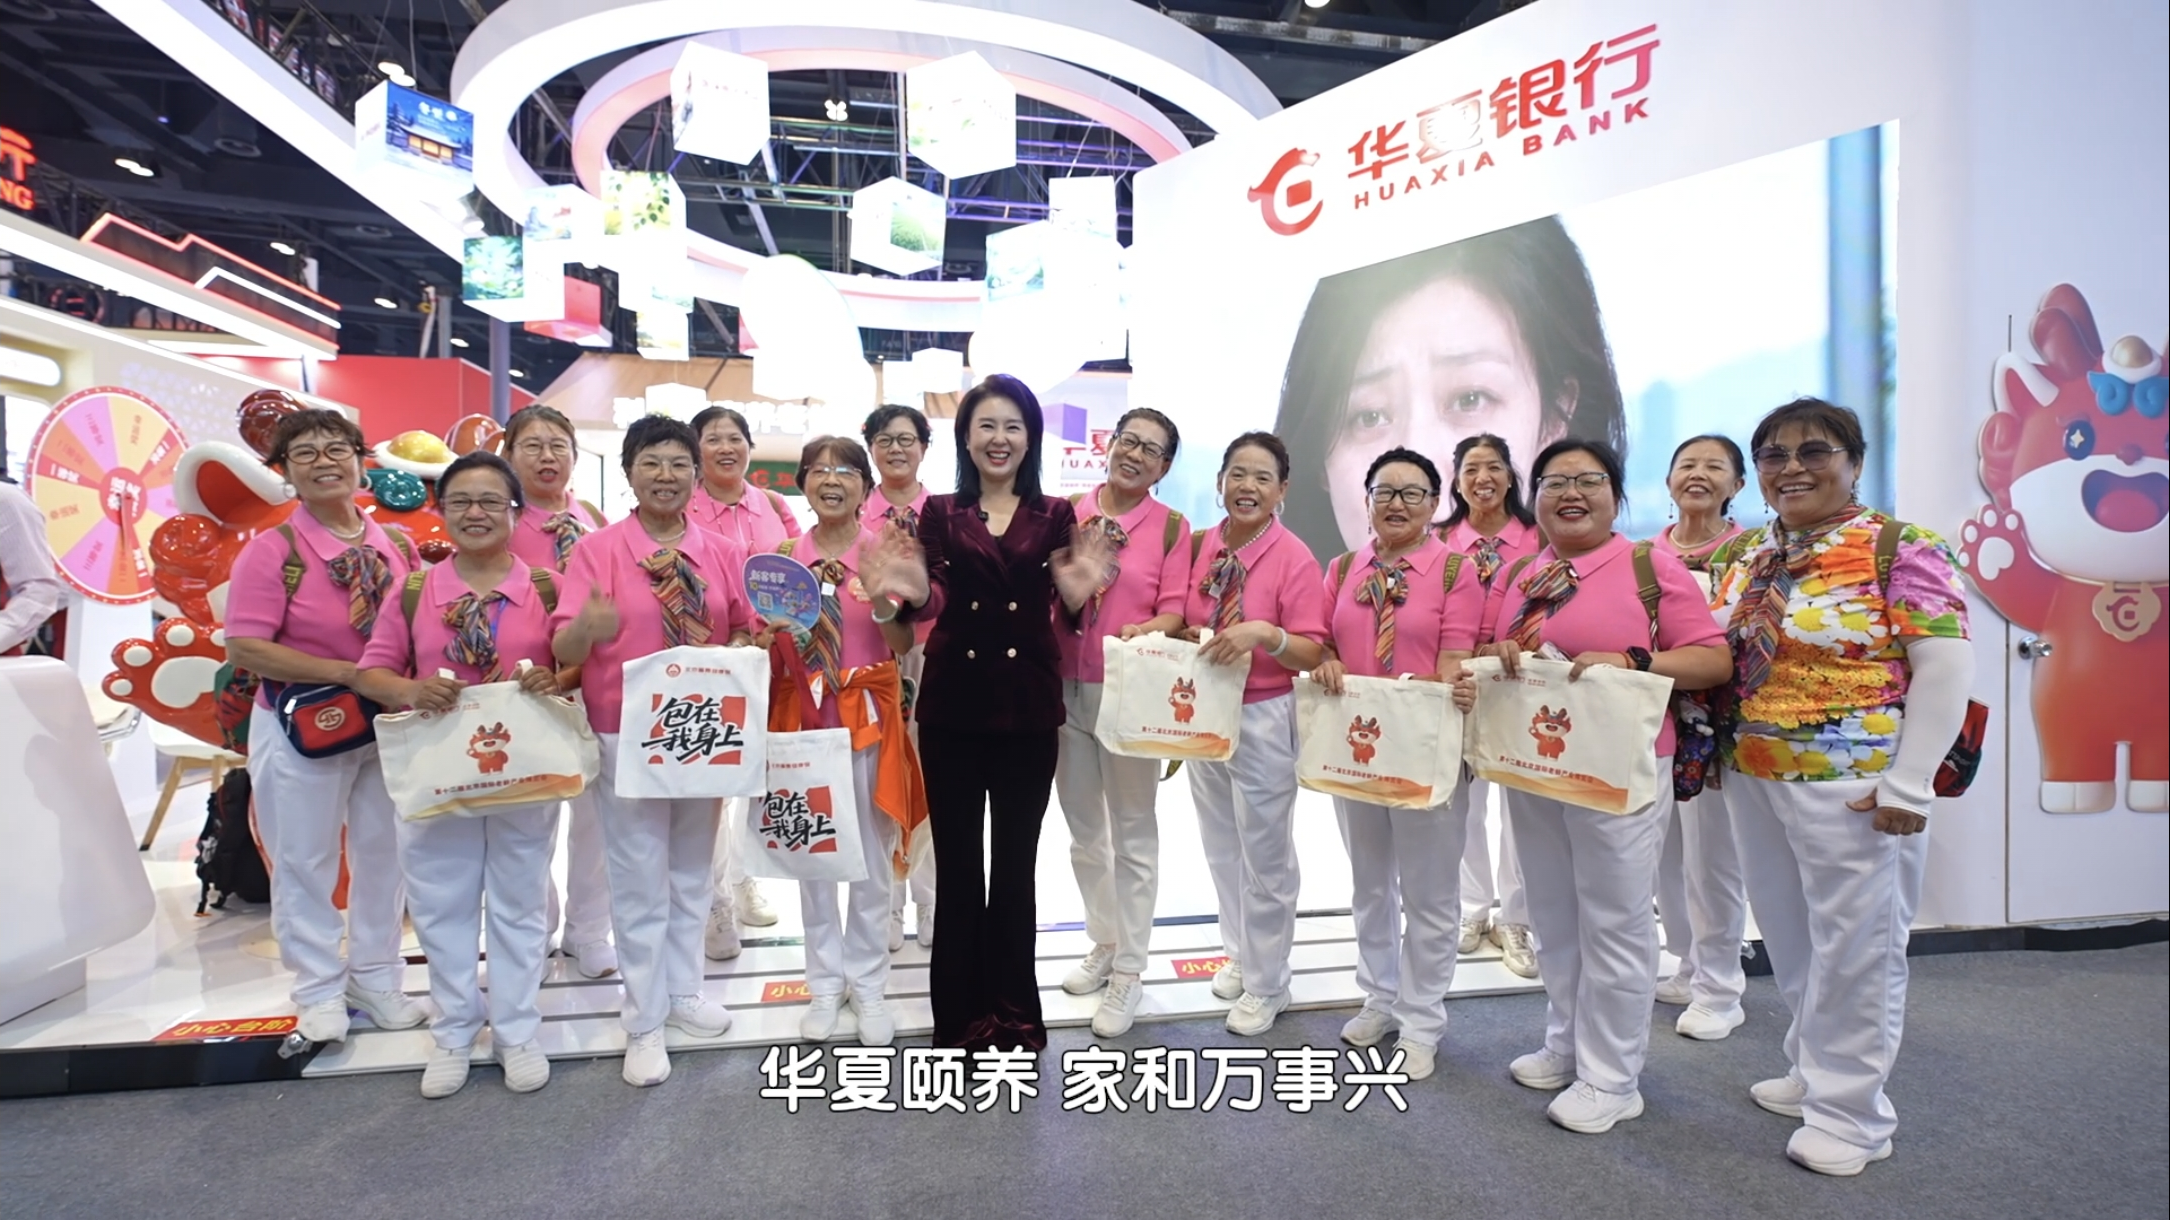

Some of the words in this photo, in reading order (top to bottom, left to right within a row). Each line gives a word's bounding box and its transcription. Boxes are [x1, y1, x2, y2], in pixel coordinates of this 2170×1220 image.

[1347, 23, 1661, 180] 华夏银行
[1354, 150, 1495, 210] HUAXIA
[1522, 97, 1650, 156] BANK
[656, 697, 721, 728] 包在
[641, 722, 744, 762] 我身上
[763, 791, 809, 819] 包在
[759, 814, 836, 848] 我身上
[172, 1018, 293, 1037] 小心台阶
